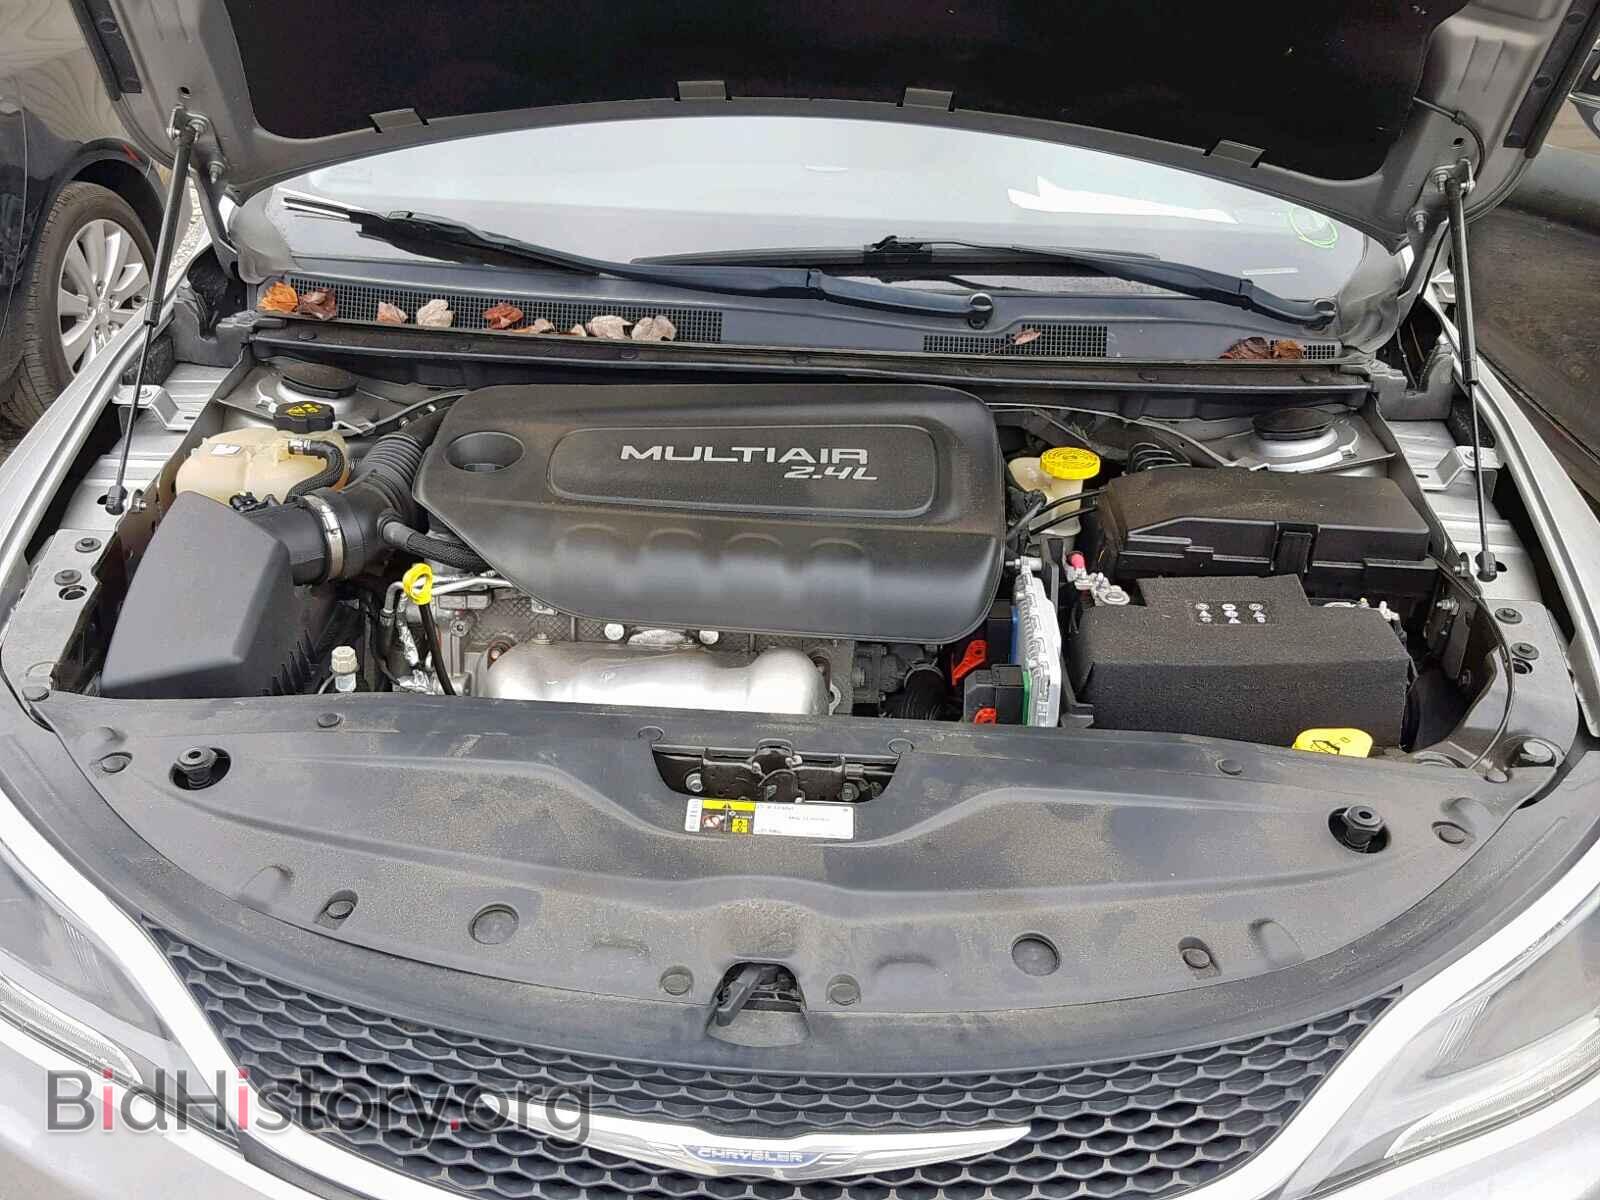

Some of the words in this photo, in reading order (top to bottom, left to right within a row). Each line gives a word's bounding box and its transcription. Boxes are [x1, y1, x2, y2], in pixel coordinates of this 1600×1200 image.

[620, 445, 868, 464] MULTIAIR
[784, 466, 878, 480] 2.4L
[697, 1149, 803, 1162] CHRYSLER
